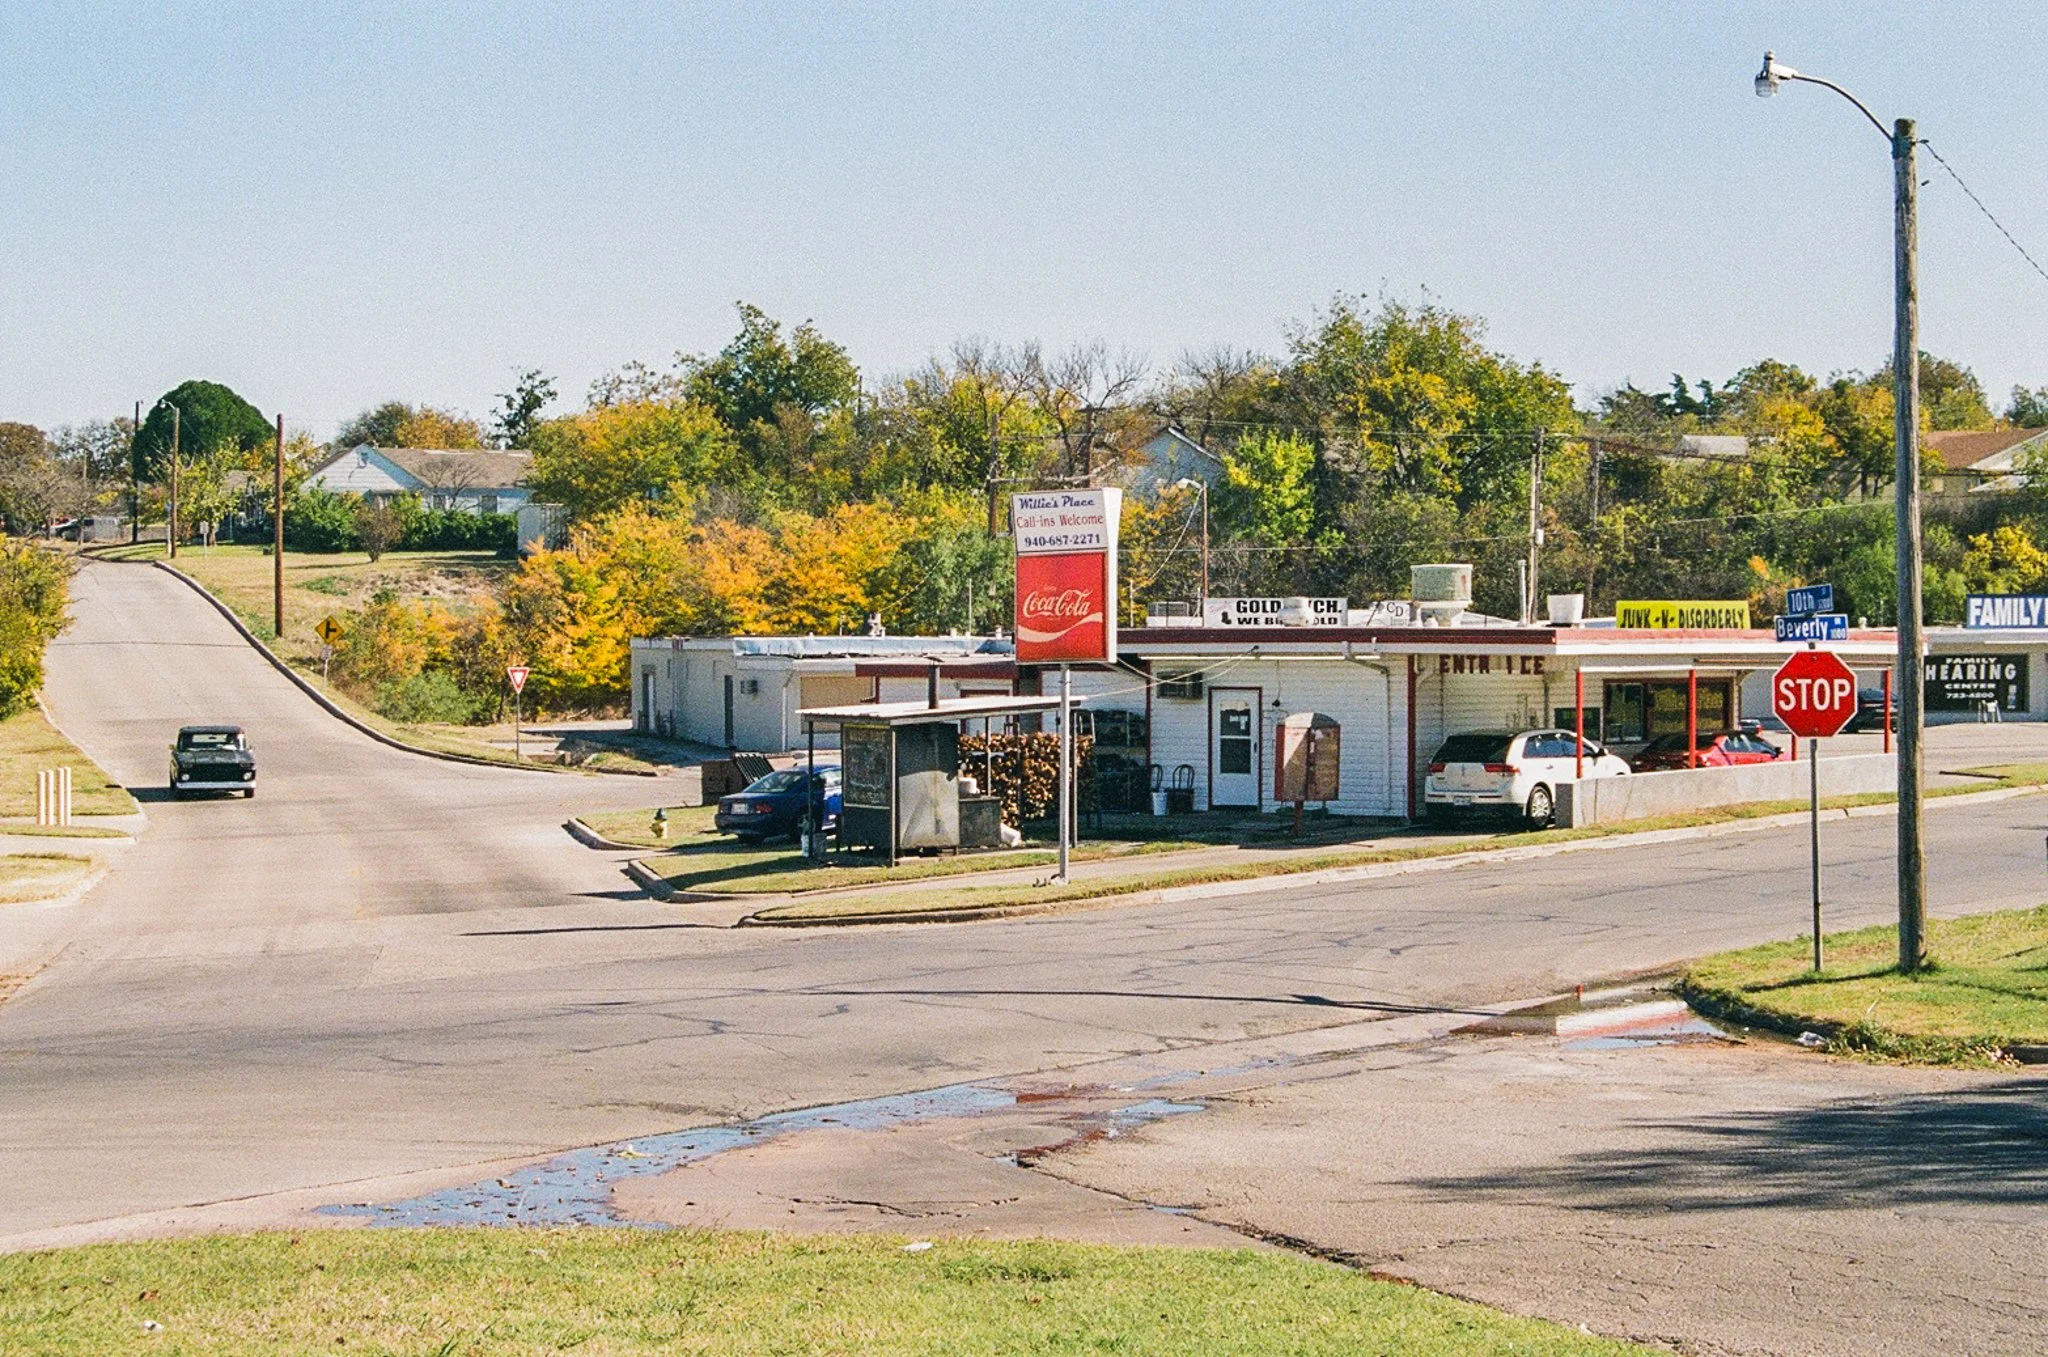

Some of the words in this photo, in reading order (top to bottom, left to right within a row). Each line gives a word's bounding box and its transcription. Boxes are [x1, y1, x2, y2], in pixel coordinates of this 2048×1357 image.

[1019, 497, 1058, 509] Willie's
[1062, 495, 1095, 507] Place
[1016, 515, 1055, 528] Call-ins
[1060, 513, 1104, 526] Welcome
[1025, 533, 1100, 547] 940-687-2271
[1023, 588, 1093, 618] Coca-Cola
[1236, 600, 1282, 613] GOLD
[1791, 591, 1815, 612] 10th
[1620, 608, 1651, 629] JUNK
[1678, 608, 1745, 629] DISORDERLY
[1969, 597, 2043, 626] FAMILY
[1237, 617, 1260, 625] WE
[1777, 618, 1829, 641] Beverly
[1946, 657, 1998, 665] FAMILY
[1925, 663, 2017, 681] HEARING
[1778, 677, 1851, 712] STOP
